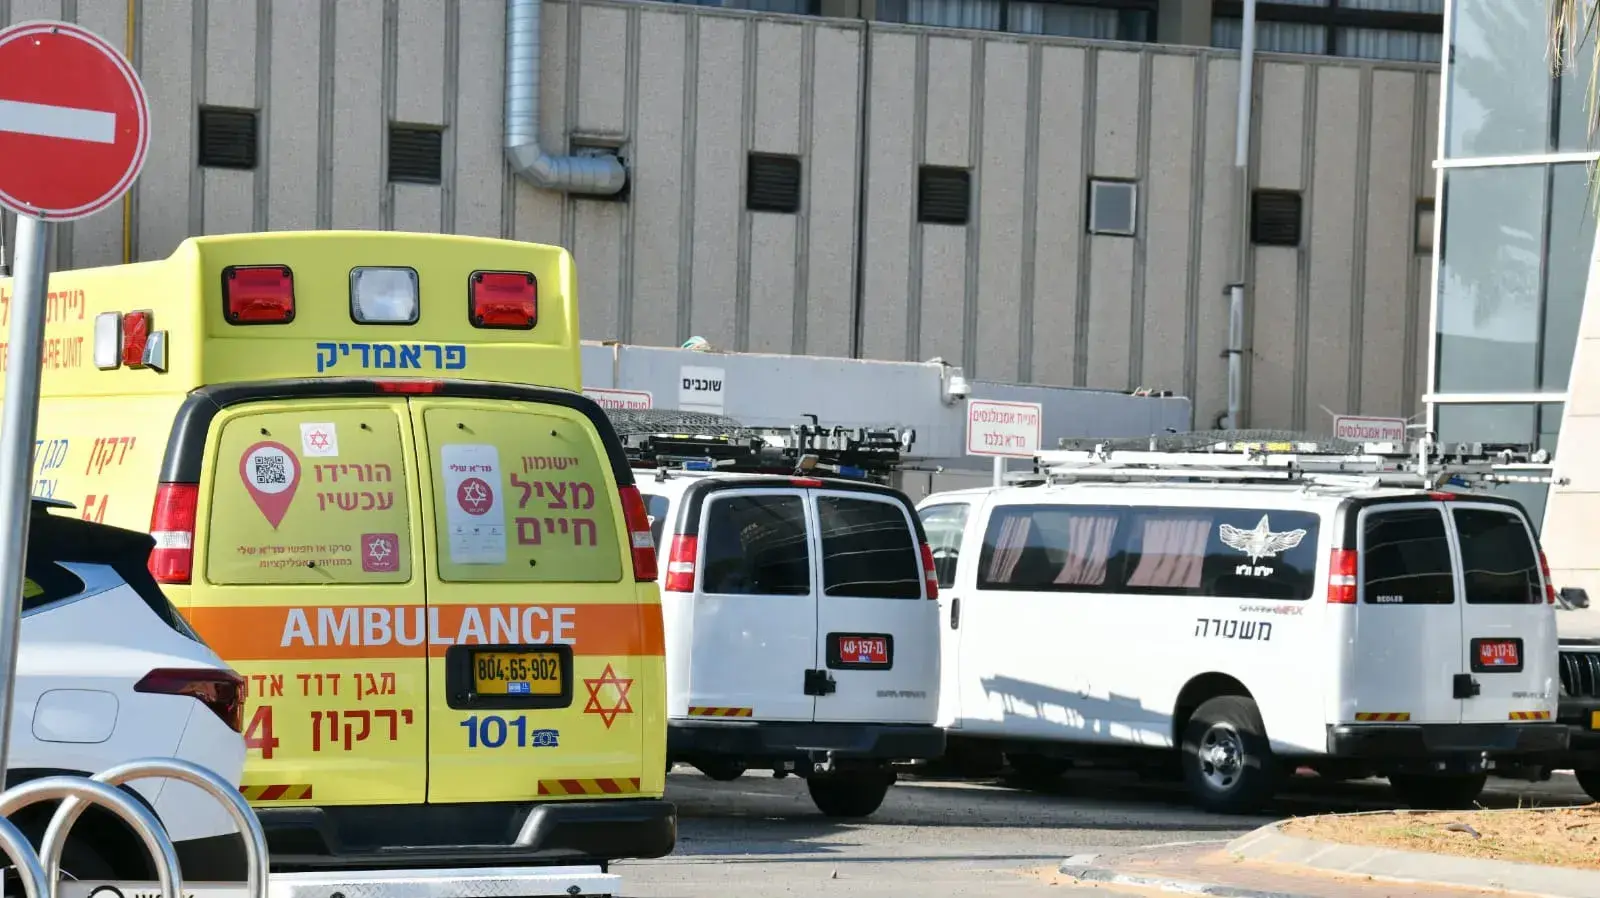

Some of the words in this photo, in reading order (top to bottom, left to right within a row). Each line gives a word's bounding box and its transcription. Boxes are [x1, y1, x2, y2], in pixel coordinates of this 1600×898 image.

[42, 338, 60, 369] ARE
[316, 342, 466, 373] פראמדיק
[682, 378, 722, 392] שוכבים
[973, 407, 1015, 424] אמבולנסים
[1017, 412, 1037, 425] חניית
[983, 431, 1004, 447] בלבד
[313, 463, 392, 482] הורידו
[449, 463, 467, 473] שלי
[521, 455, 579, 474] יישומון
[317, 491, 394, 511] עכשיו
[510, 472, 595, 510] מציל
[515, 517, 597, 546] חיים
[280, 606, 577, 647] AMBULANCE
[1194, 618, 1273, 641] משטרה
[296, 673, 341, 697] דוד
[353, 672, 396, 701] מגן
[310, 709, 414, 752] ירקון
[459, 715, 527, 748] 101
